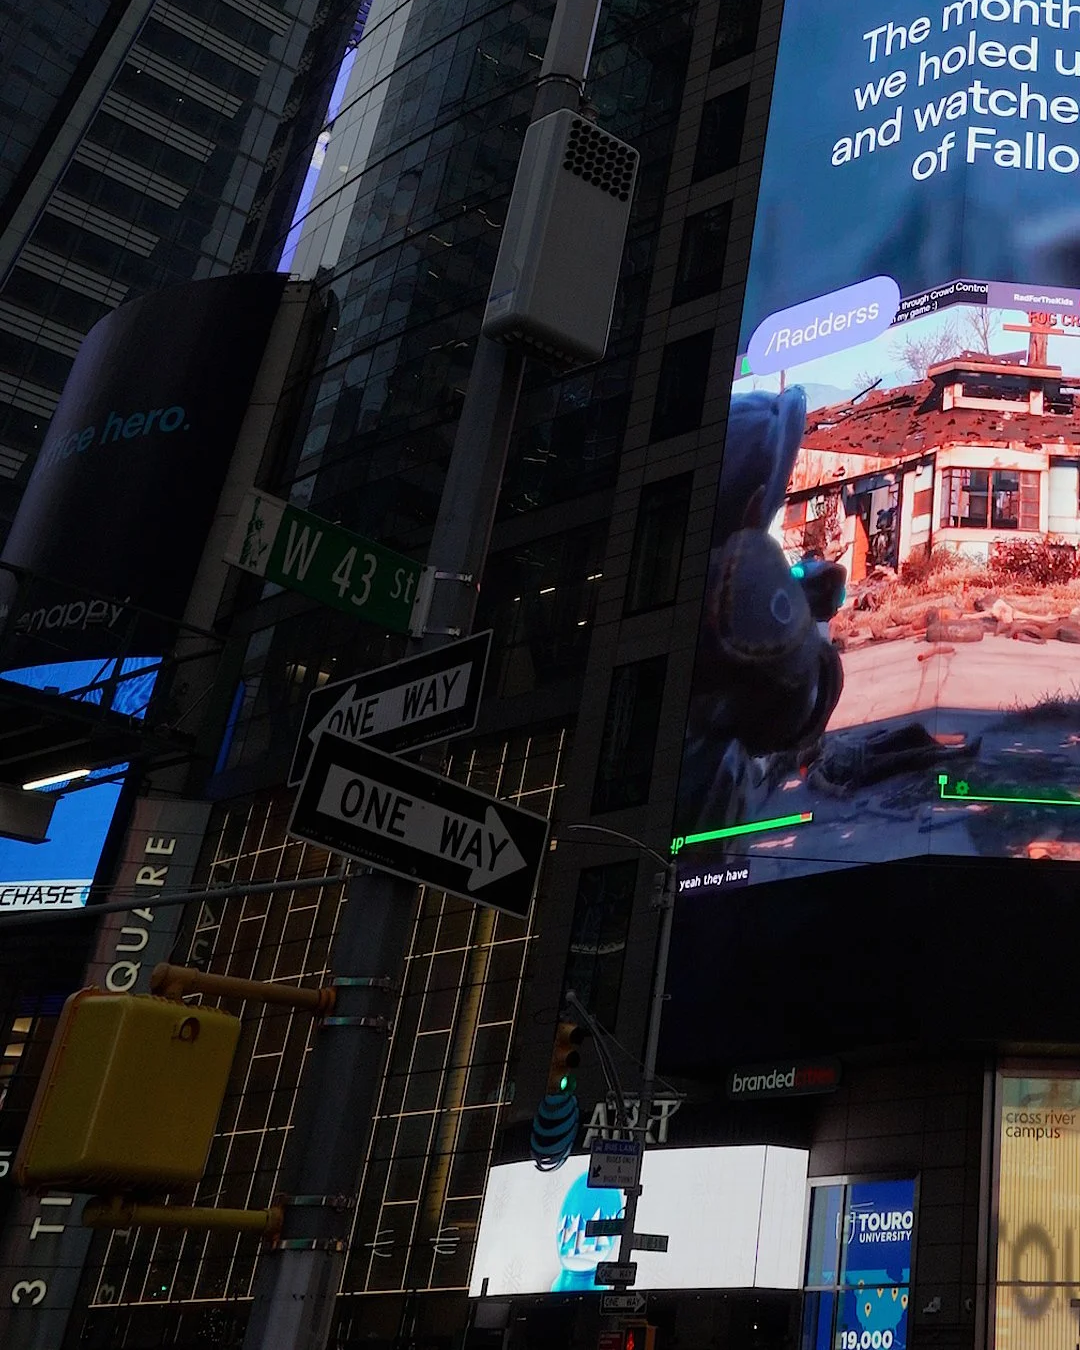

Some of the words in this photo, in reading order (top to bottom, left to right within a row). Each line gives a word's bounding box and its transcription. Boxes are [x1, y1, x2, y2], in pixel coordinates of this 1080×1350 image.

[863, 19, 930, 63] The
[854, 69, 906, 111] we
[918, 31, 1039, 87] holed
[831, 108, 901, 167] and
[911, 140, 955, 182] of
[902, 295, 929, 310] through
[930, 285, 954, 299] Crowd
[956, 283, 988, 293] Control
[1014, 294, 1073, 306] RadForTheKids
[910, 305, 931, 318] game
[764, 301, 879, 356] /Radderss
[99, 405, 191, 444] hero.
[282, 519, 323, 582] W
[332, 546, 378, 606] 43
[328, 697, 380, 738] ONE
[402, 670, 461, 722] WAY
[340, 778, 413, 838] ONE
[440, 816, 509, 872] WAY
[679, 877, 701, 892] yeah
[704, 872, 723, 887] they
[726, 867, 748, 881] have
[0, 886, 77, 905] CHASE
[105, 837, 176, 992] QUARE
[1006, 1112, 1041, 1124] cross
[1045, 1110, 1076, 1124] river
[1006, 1126, 1060, 1141] campus
[859, 1211, 914, 1231] TOURO
[859, 1230, 912, 1243] UNIVERSITY
[11, 1278, 48, 1306] 3
[841, 1330, 893, 1350] 19,000
